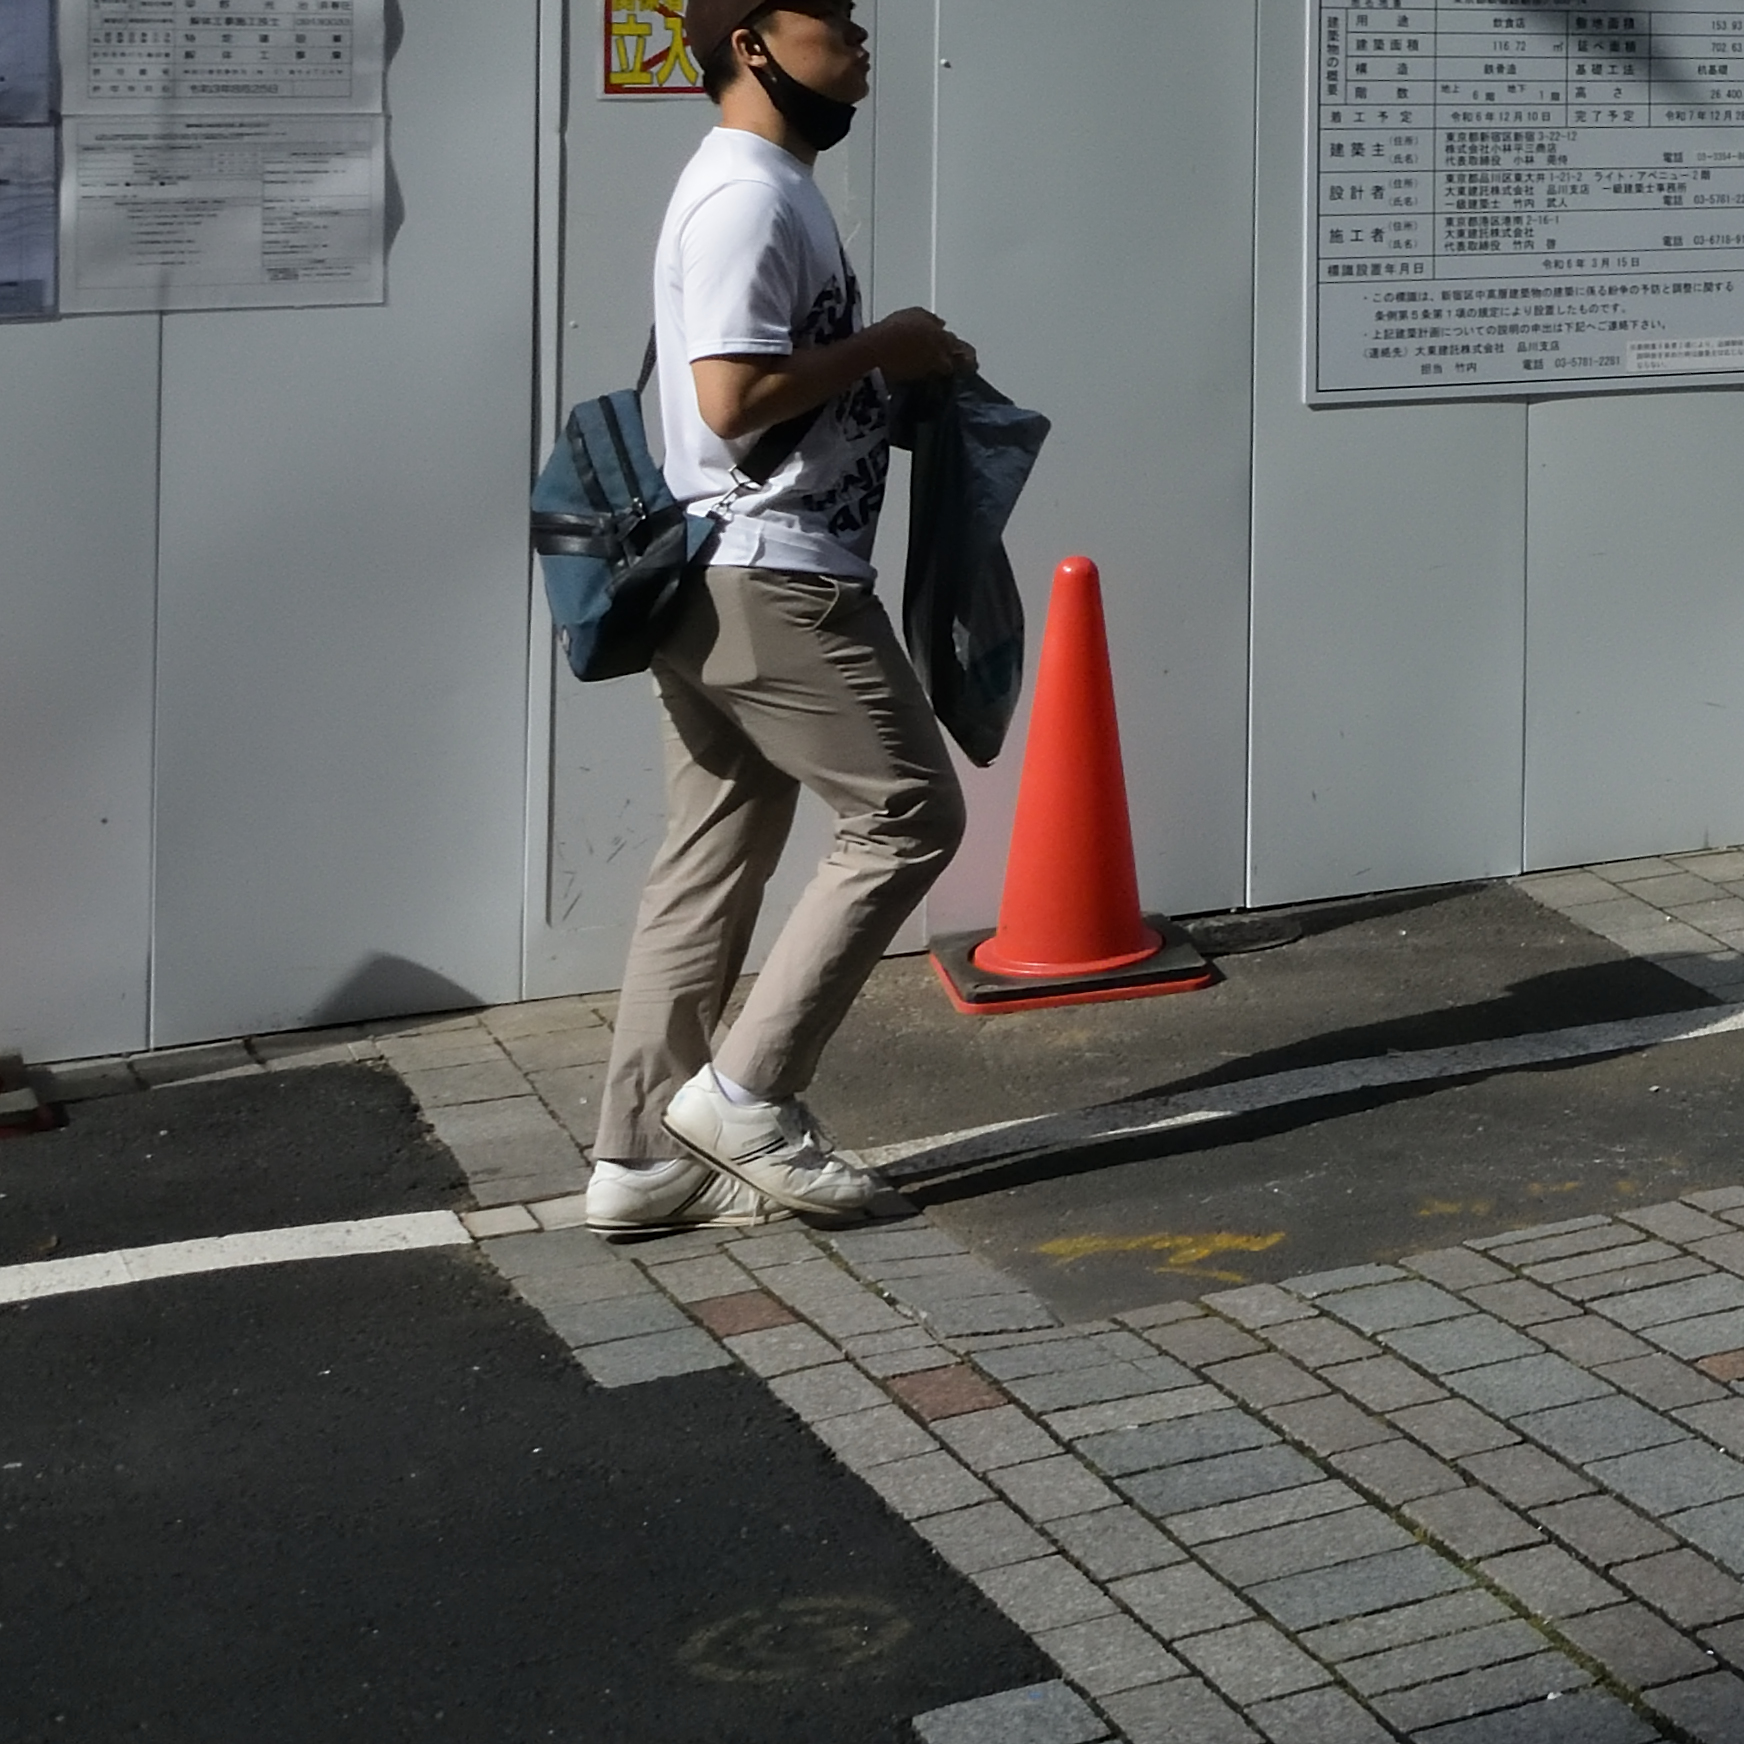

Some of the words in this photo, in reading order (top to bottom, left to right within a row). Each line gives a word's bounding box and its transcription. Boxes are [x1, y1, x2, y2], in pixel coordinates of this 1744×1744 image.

[1329, 141, 1386, 159] 建築主
[1328, 184, 1387, 202] 設計者
[1328, 227, 1387, 245] 施工者
